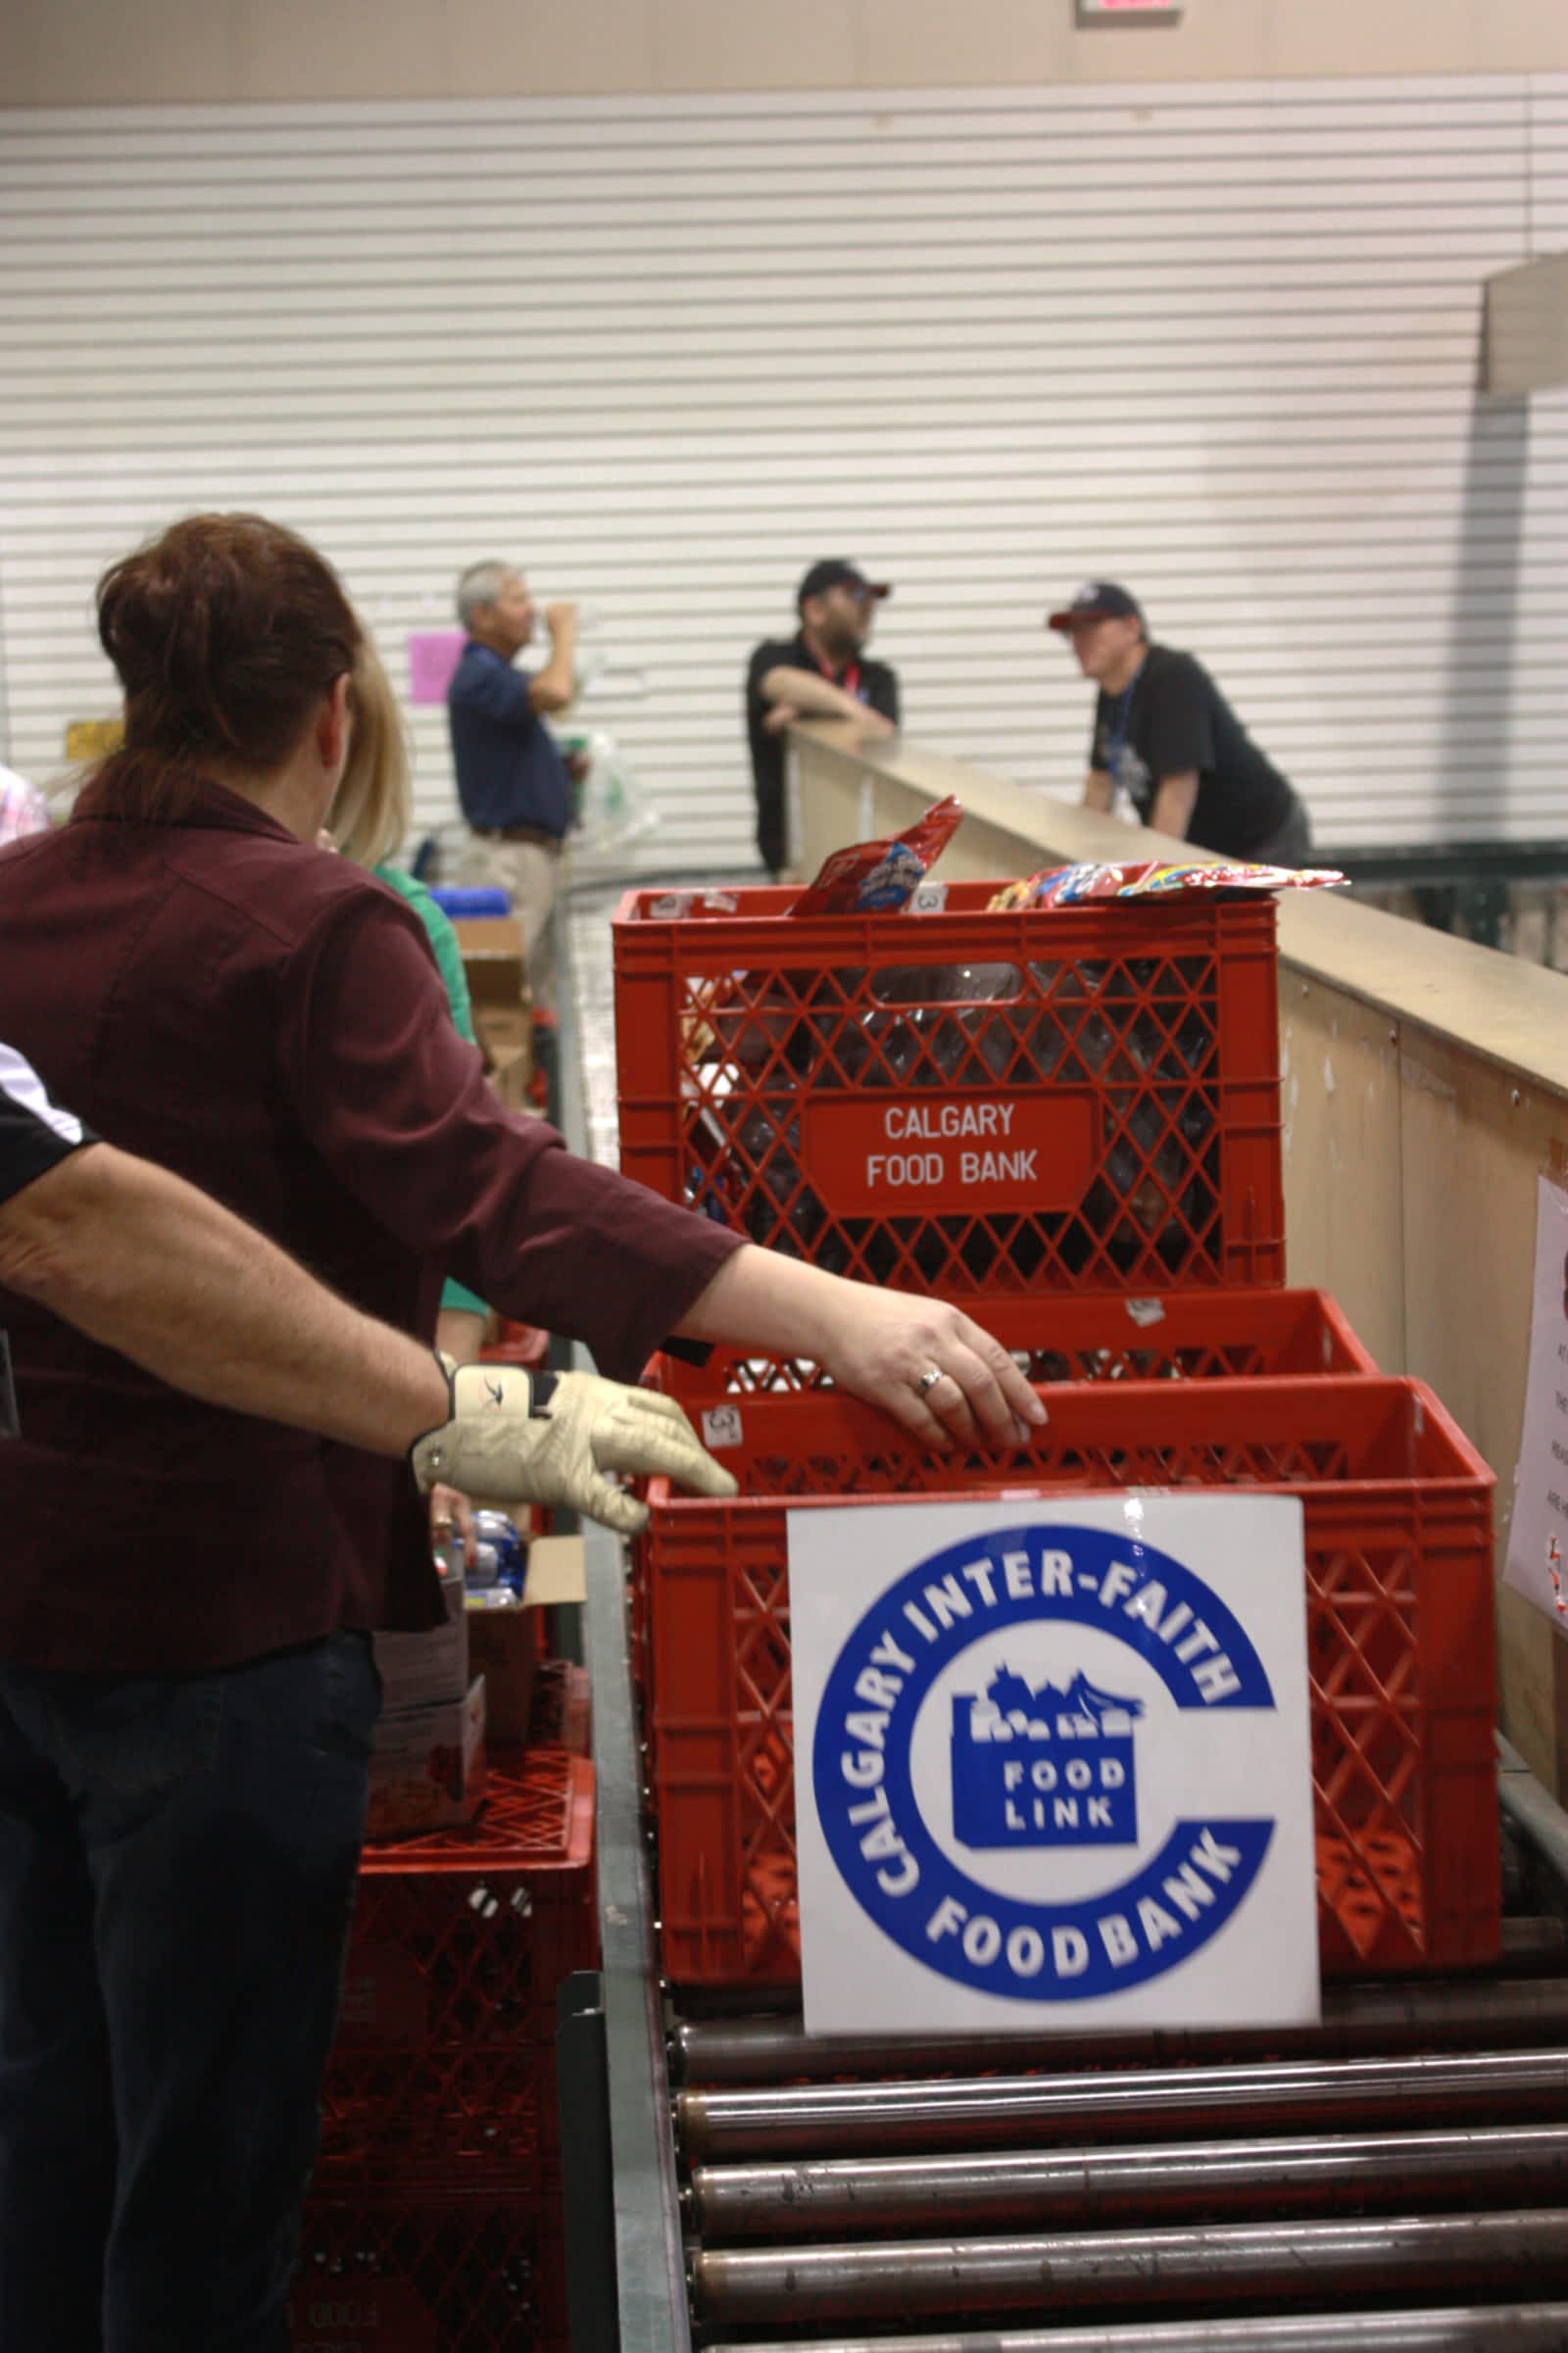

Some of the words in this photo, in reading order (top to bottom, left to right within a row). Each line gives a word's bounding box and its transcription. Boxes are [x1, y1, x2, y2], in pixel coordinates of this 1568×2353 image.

[885, 1103, 1015, 1140] CALGARY
[866, 1152, 945, 1188] FOOD
[959, 1149, 1039, 1184] BANK
[841, 1631, 921, 1898] CALGARY
[902, 1548, 1244, 1705] INTER-FAITH
[1004, 1757, 1125, 1792] FOOD
[1004, 1795, 1114, 1831] LINK
[925, 1896, 1089, 1978] FOOD
[1098, 1828, 1243, 1968] BANK
